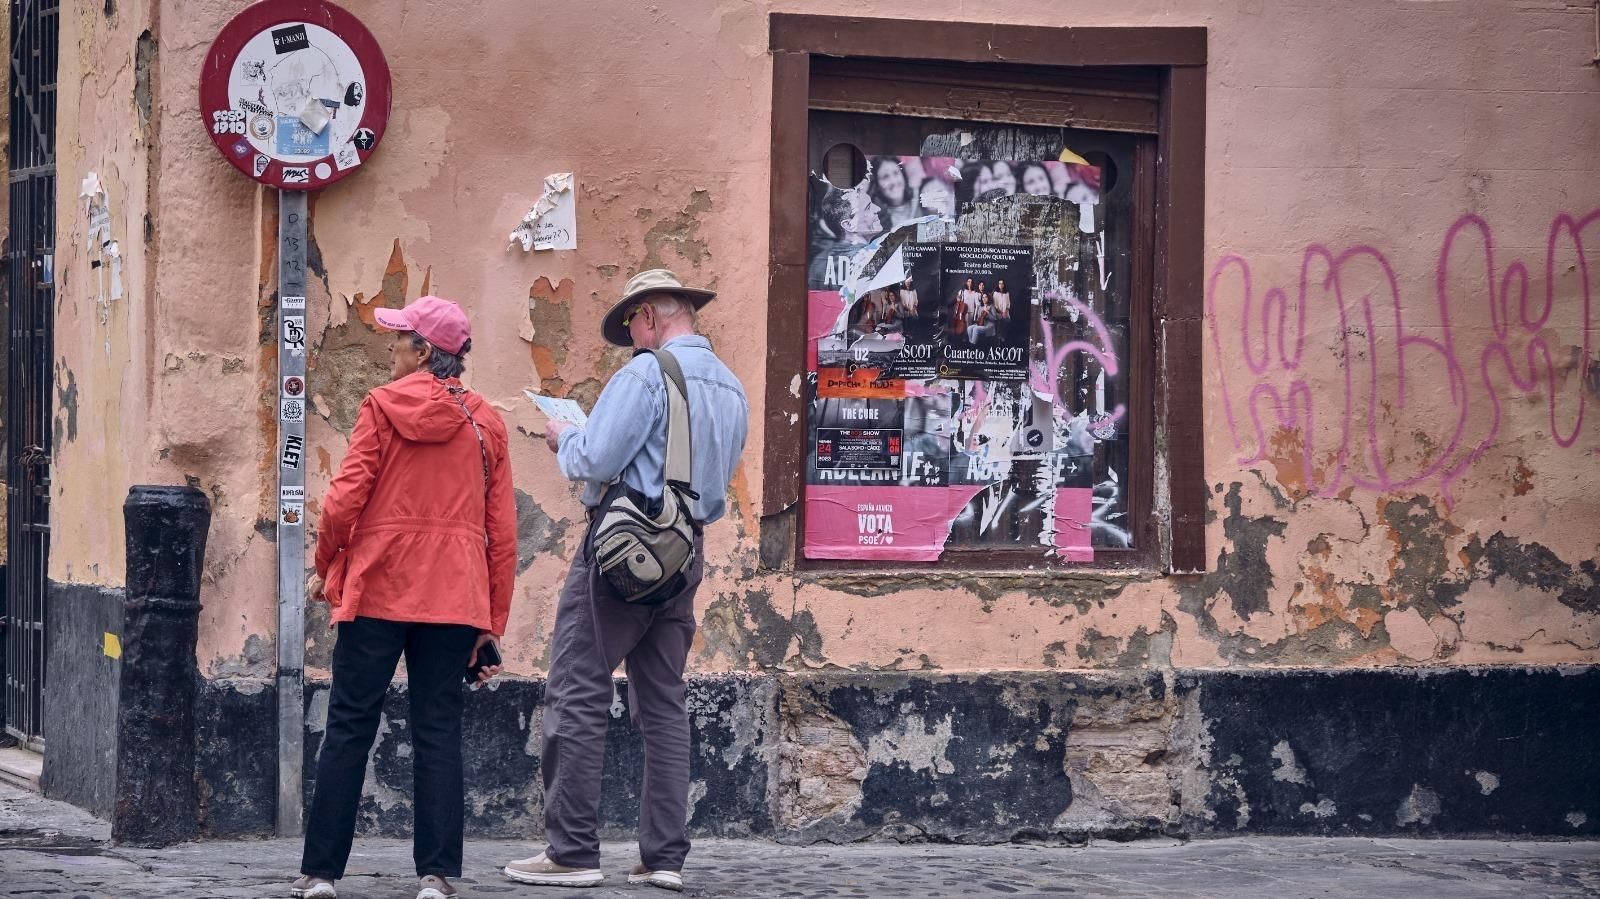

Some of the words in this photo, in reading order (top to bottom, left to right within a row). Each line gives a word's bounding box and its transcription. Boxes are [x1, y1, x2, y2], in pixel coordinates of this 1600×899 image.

[213, 110, 246, 122] FCSP
[213, 121, 246, 134] 1910
[854, 347, 869, 361] U2
[943, 344, 985, 360] Cuarteto
[986, 346, 1024, 361] ASCOT
[842, 407, 857, 420] THE
[858, 408, 879, 420] CURE
[282, 434, 303, 469] KLET
[818, 443, 832, 453] 24
[857, 502, 875, 512] ESPAÑA
[857, 513, 893, 534] VOTA
[858, 535, 879, 545] PSOE
